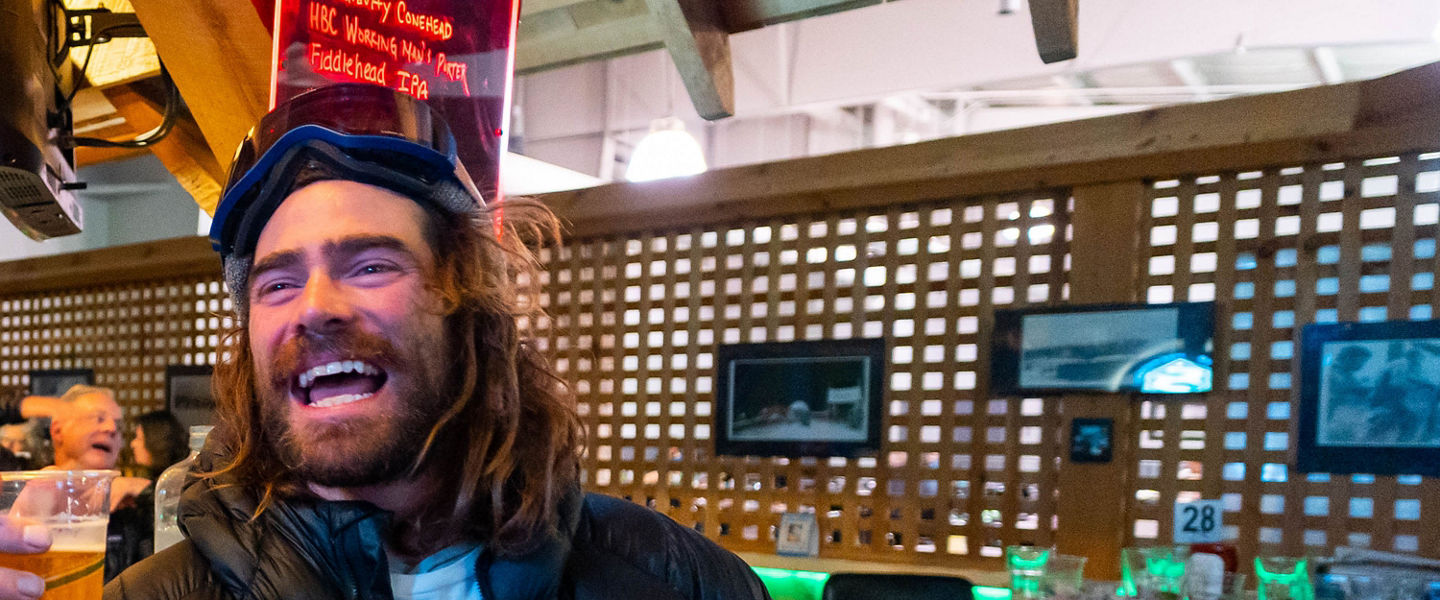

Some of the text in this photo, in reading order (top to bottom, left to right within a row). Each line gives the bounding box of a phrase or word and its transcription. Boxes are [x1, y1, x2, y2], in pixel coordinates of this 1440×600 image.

[310, 2, 338, 35] HBC
[311, 43, 428, 99] Fiddlehead IPA
[1182, 504, 1216, 533] 28
